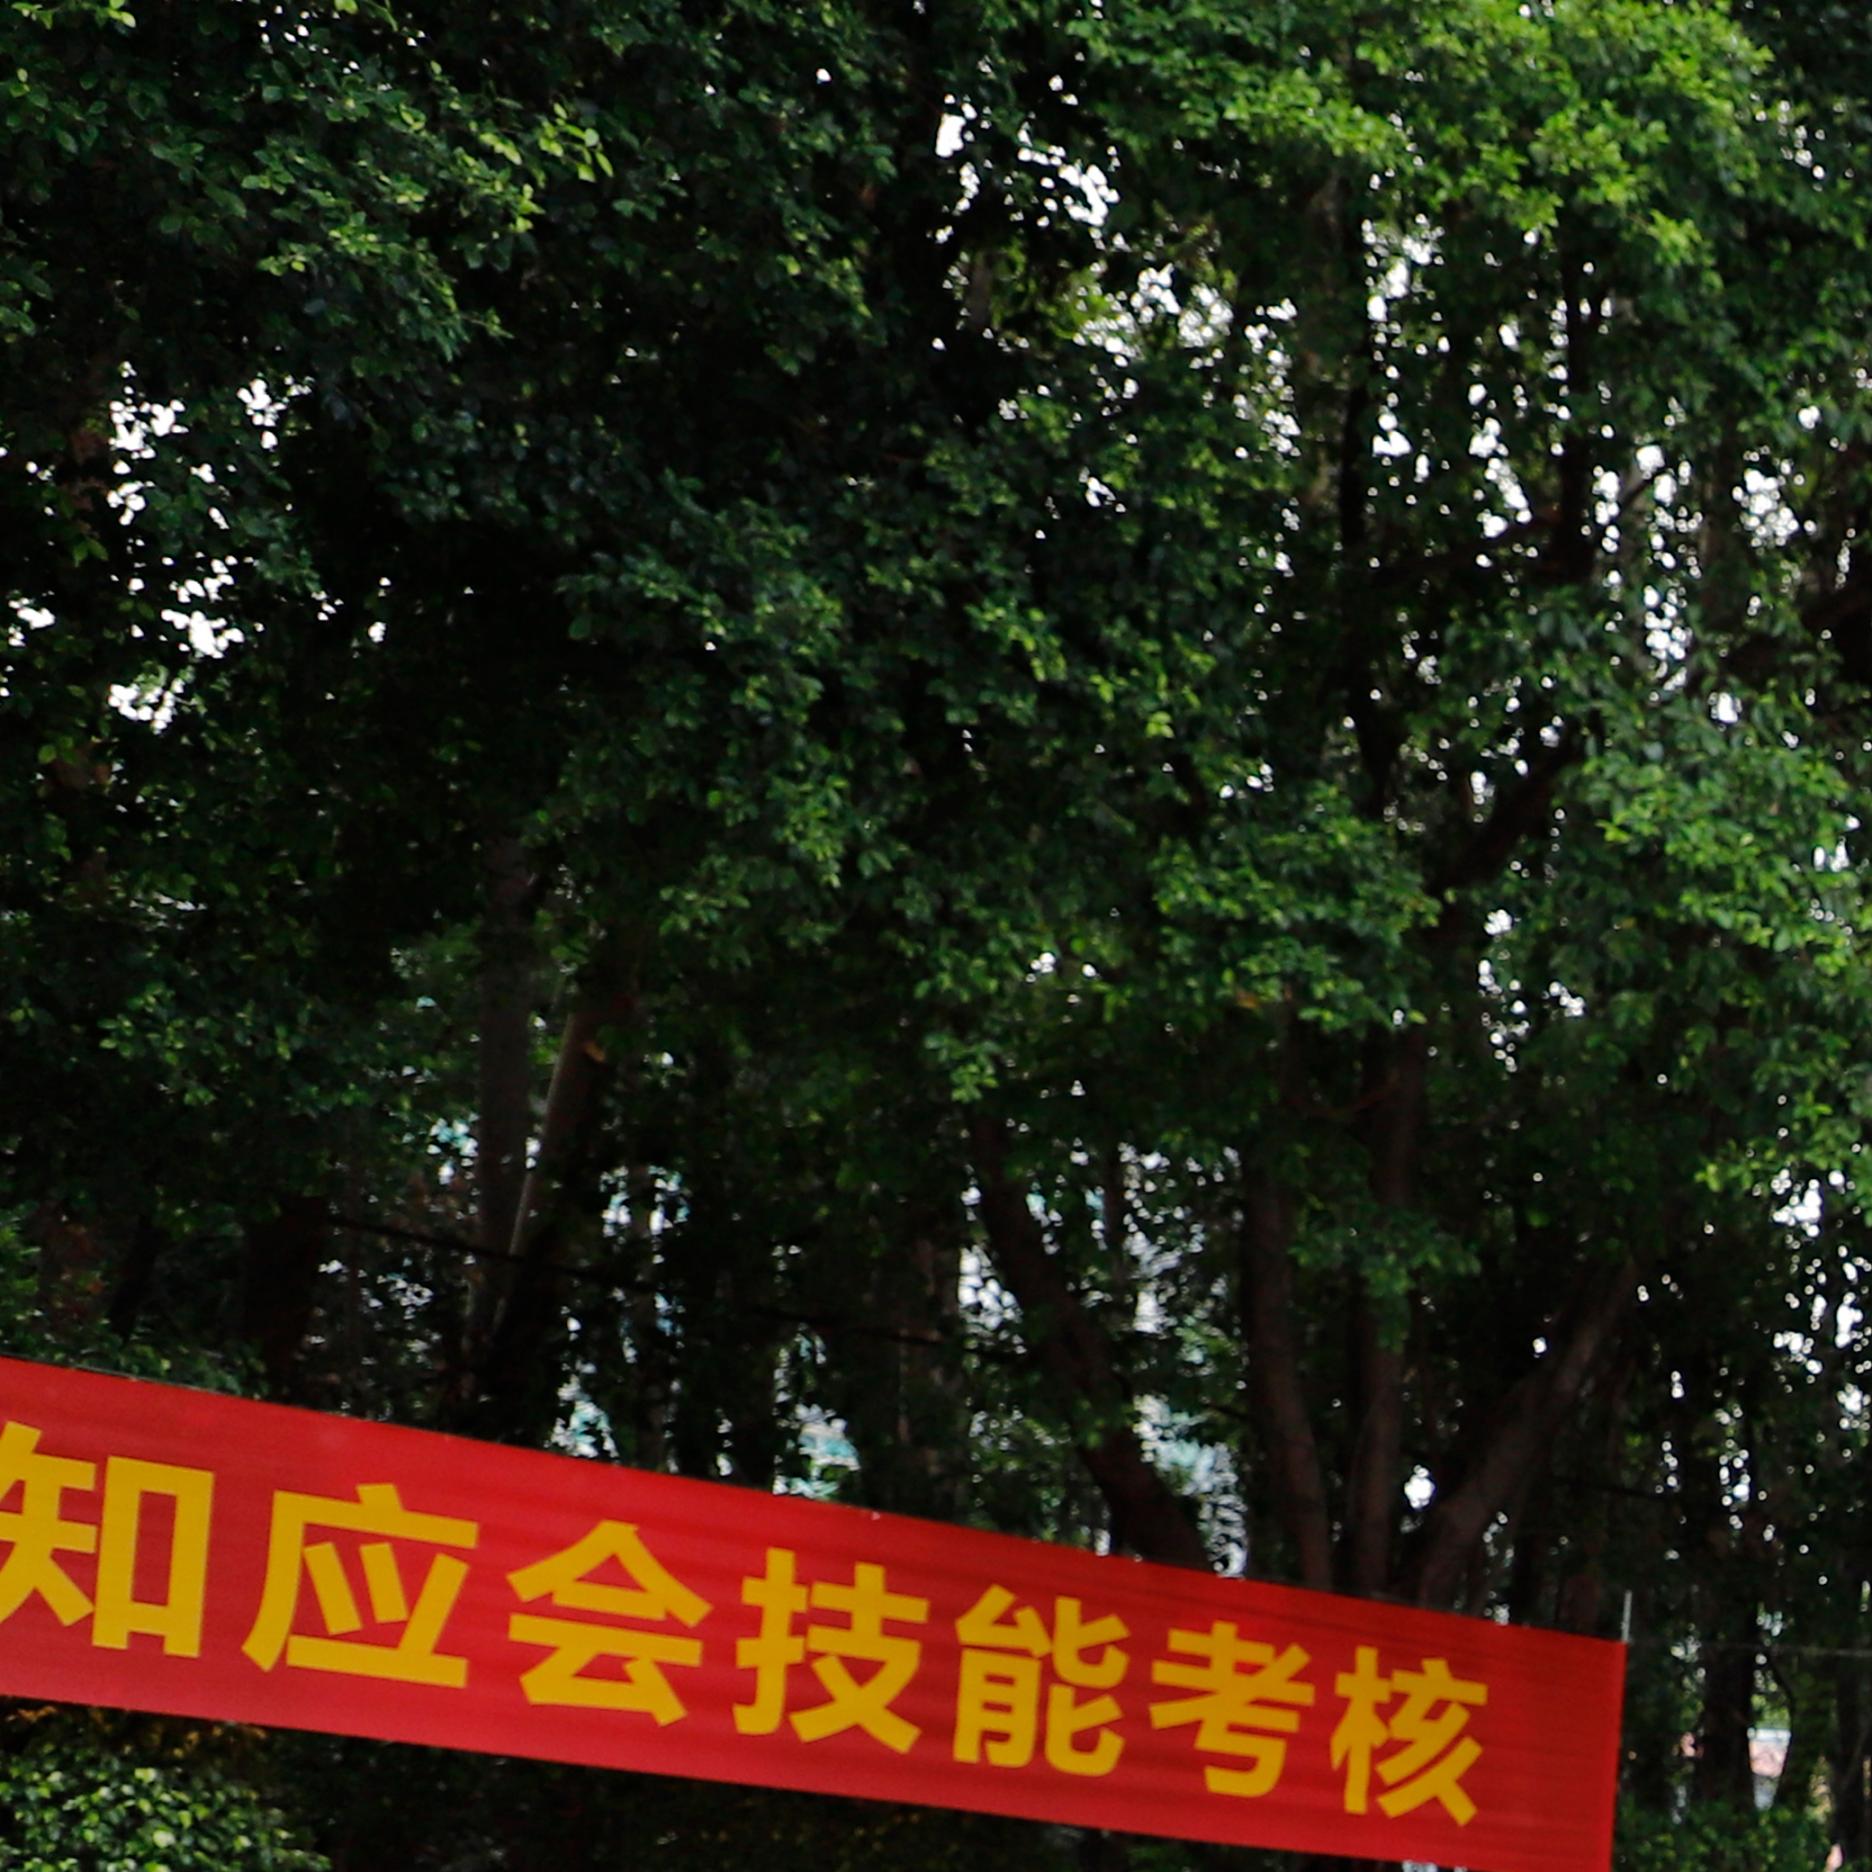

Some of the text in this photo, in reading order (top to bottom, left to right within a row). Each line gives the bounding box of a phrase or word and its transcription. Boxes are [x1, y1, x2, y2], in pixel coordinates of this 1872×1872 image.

[0, 1421, 1487, 1826] 知应会技能考核
